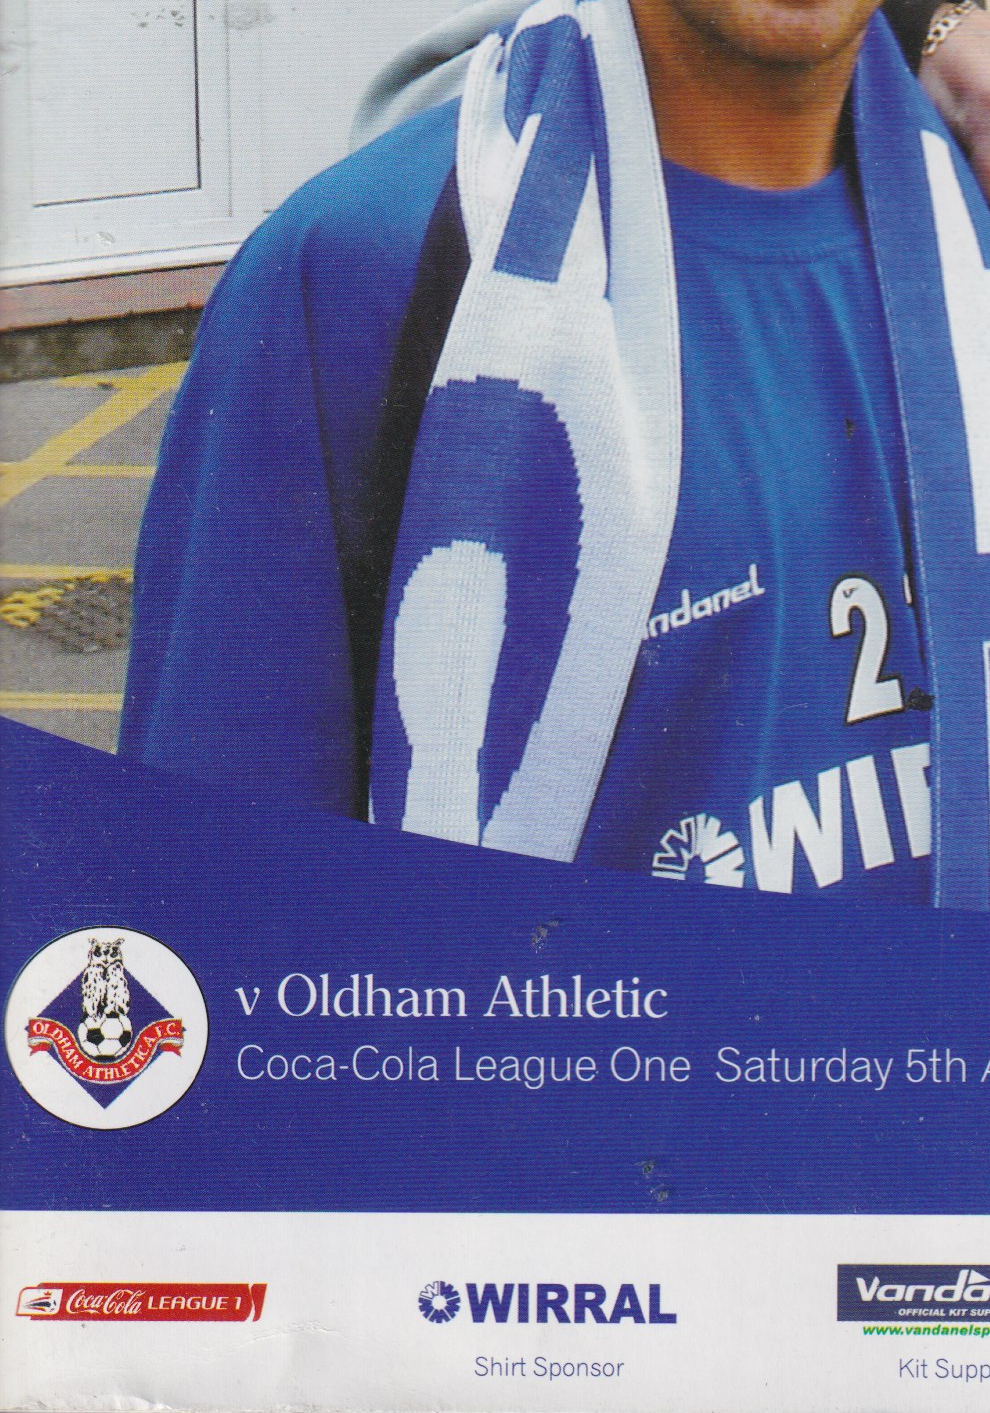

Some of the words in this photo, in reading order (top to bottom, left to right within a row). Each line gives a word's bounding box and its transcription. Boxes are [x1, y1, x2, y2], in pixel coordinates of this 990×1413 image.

[642, 563, 766, 641] ndanel
[234, 987, 261, 1016] v
[277, 972, 468, 1018] Oldham
[483, 974, 668, 1019] Athletic
[32, 1021, 84, 1070] OLDHAM
[82, 1044, 152, 1080] ATHLETIC
[237, 1044, 440, 1081] Coca-Cola
[455, 1046, 597, 1090] League
[610, 1046, 691, 1082] One
[715, 1046, 894, 1091] Saturday
[906, 1048, 966, 1083] 5th
[148, 1296, 228, 1310] LEAGUE
[234, 1296, 242, 1310] 1
[465, 1282, 678, 1325] WIRRAL
[897, 1308, 946, 1317] OFFICIAL
[949, 1308, 968, 1317] KIT
[474, 1356, 527, 1378] Shirt
[533, 1356, 625, 1381] Sponsor
[899, 1358, 928, 1379] Kit
